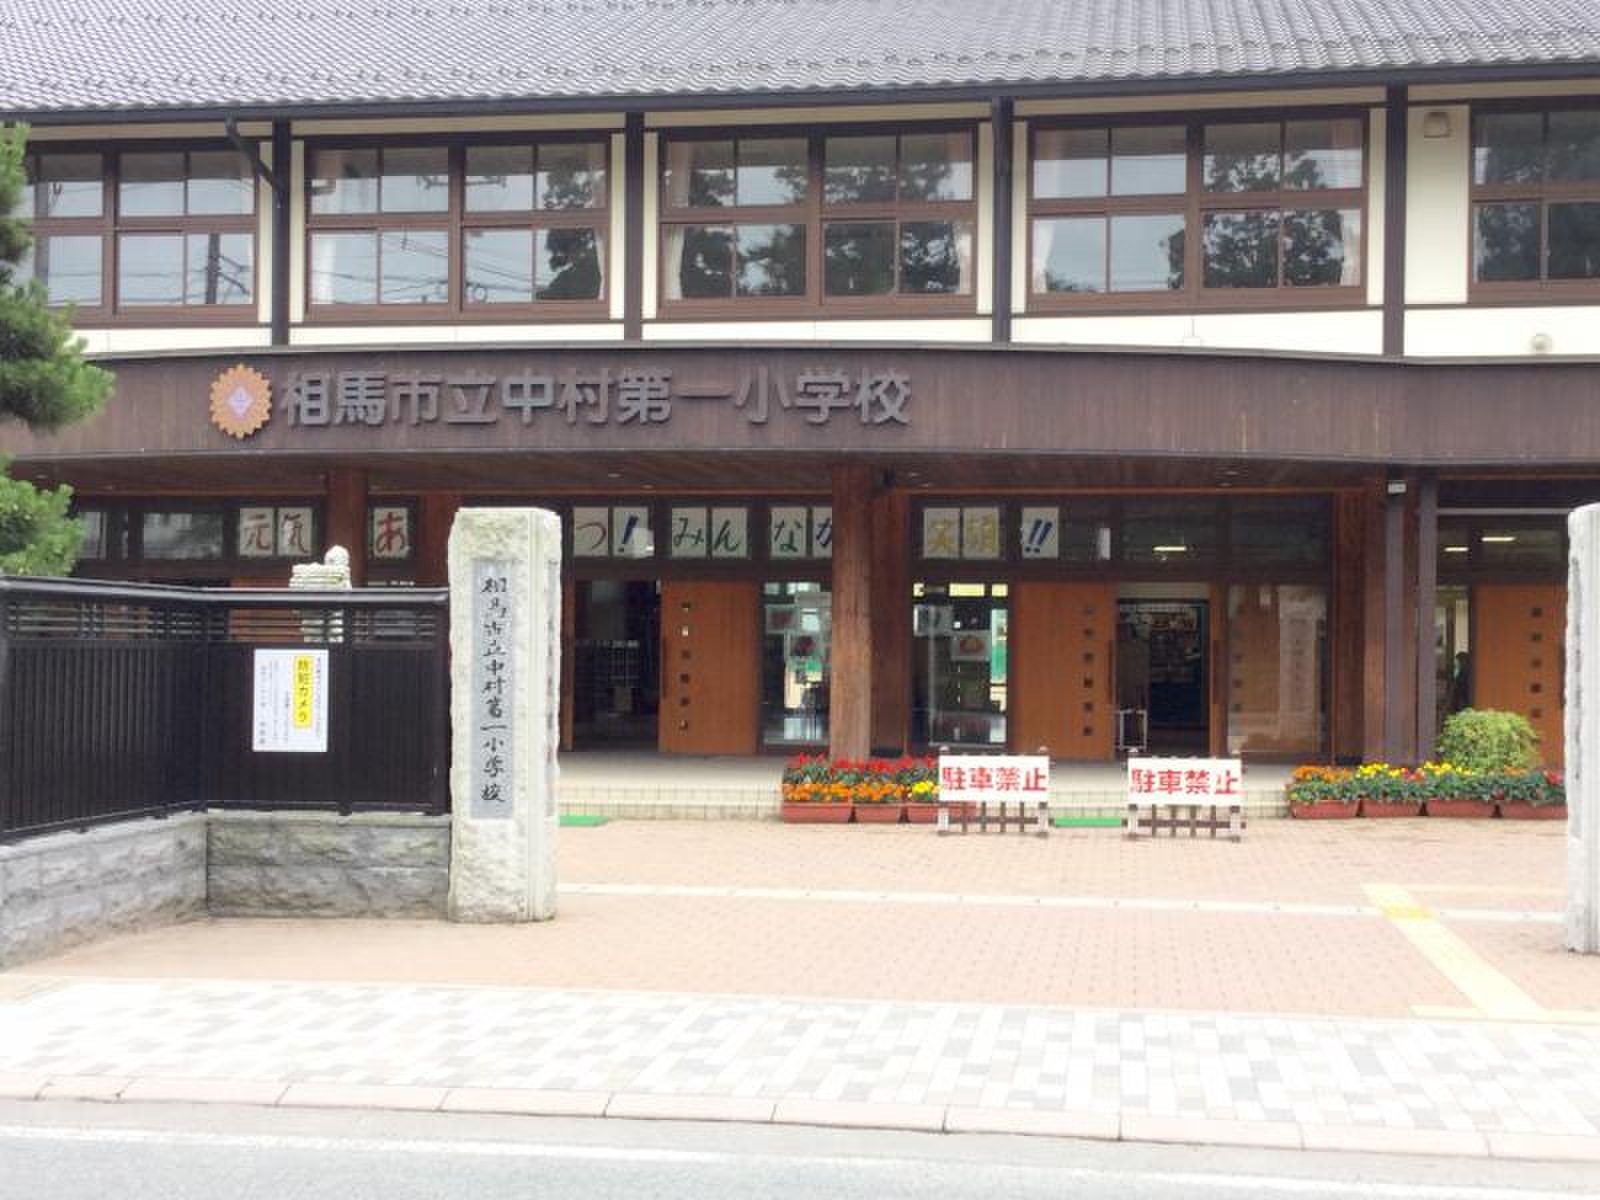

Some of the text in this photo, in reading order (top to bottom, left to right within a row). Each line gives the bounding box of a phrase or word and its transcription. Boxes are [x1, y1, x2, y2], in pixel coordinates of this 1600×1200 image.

[281, 367, 911, 425] 相馬市立中村第一小学校
[244, 513, 309, 554] 元気
[376, 512, 406, 553] あ
[942, 766, 1048, 792] 駐車禁止
[1131, 769, 1238, 796] 駐車禁止
